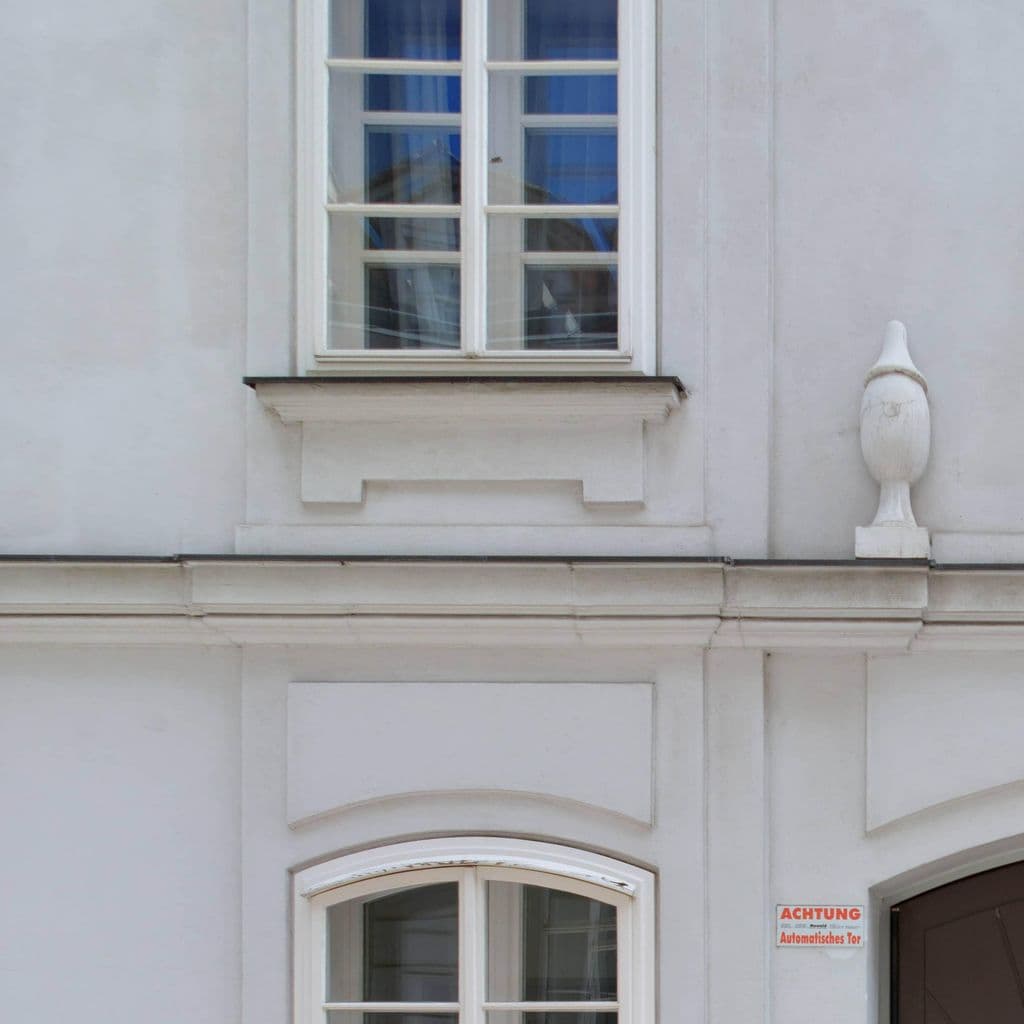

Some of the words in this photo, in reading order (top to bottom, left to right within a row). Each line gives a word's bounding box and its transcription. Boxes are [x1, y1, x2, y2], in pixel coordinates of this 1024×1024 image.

[780, 907, 861, 920] ACHTUNG
[780, 931, 845, 944] Automatisches
[847, 931, 861, 944] Tor
